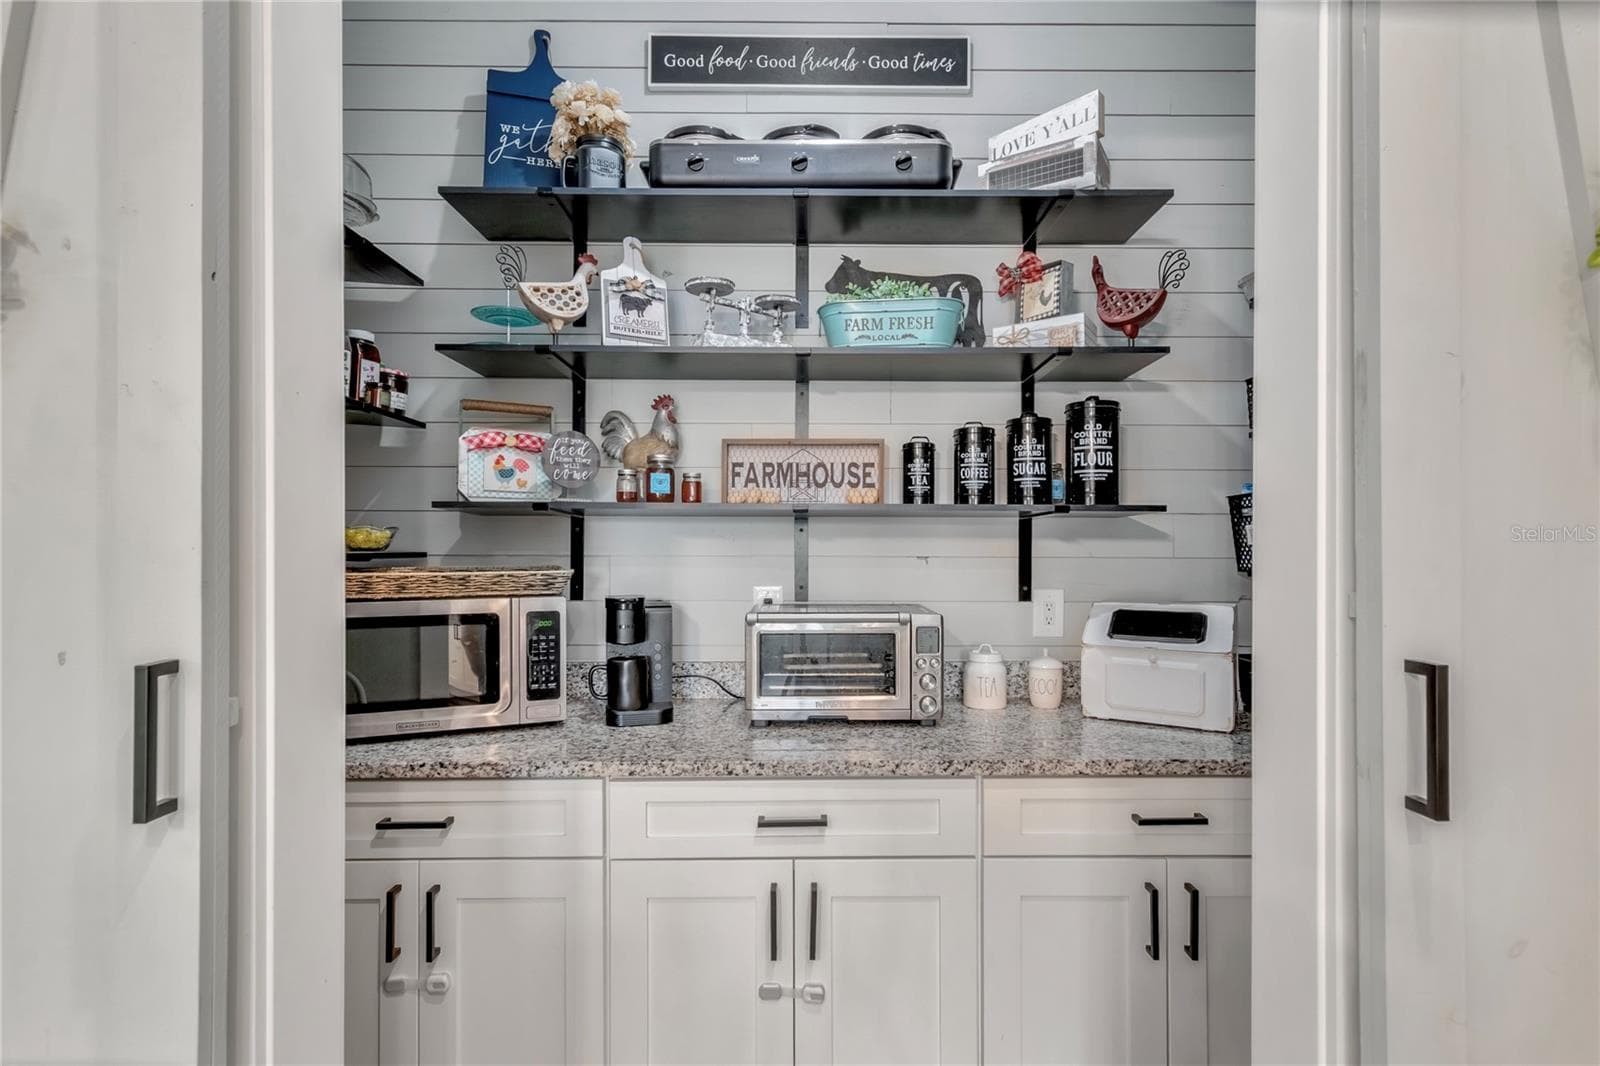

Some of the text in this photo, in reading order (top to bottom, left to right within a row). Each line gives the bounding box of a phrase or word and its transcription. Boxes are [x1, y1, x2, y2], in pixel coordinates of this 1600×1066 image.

[663, 45, 957, 75] Good food Good friends Good times
[499, 123, 521, 134] WE
[991, 107, 1097, 162] LOVE Y'ALL
[843, 315, 935, 332] FARM FRESH
[872, 334, 901, 342] LOCAL
[1073, 430, 1113, 439] COUNTRY
[1079, 437, 1108, 445] BRAND
[549, 438, 592, 465] feed
[1073, 451, 1114, 467] FLOUR
[553, 468, 593, 481] come
[731, 461, 876, 489] FARMHOUSE
[960, 467, 989, 479] COFFEE
[1012, 461, 1047, 476] SUGAR
[910, 475, 928, 486] TEA
[976, 676, 998, 698] TEA
